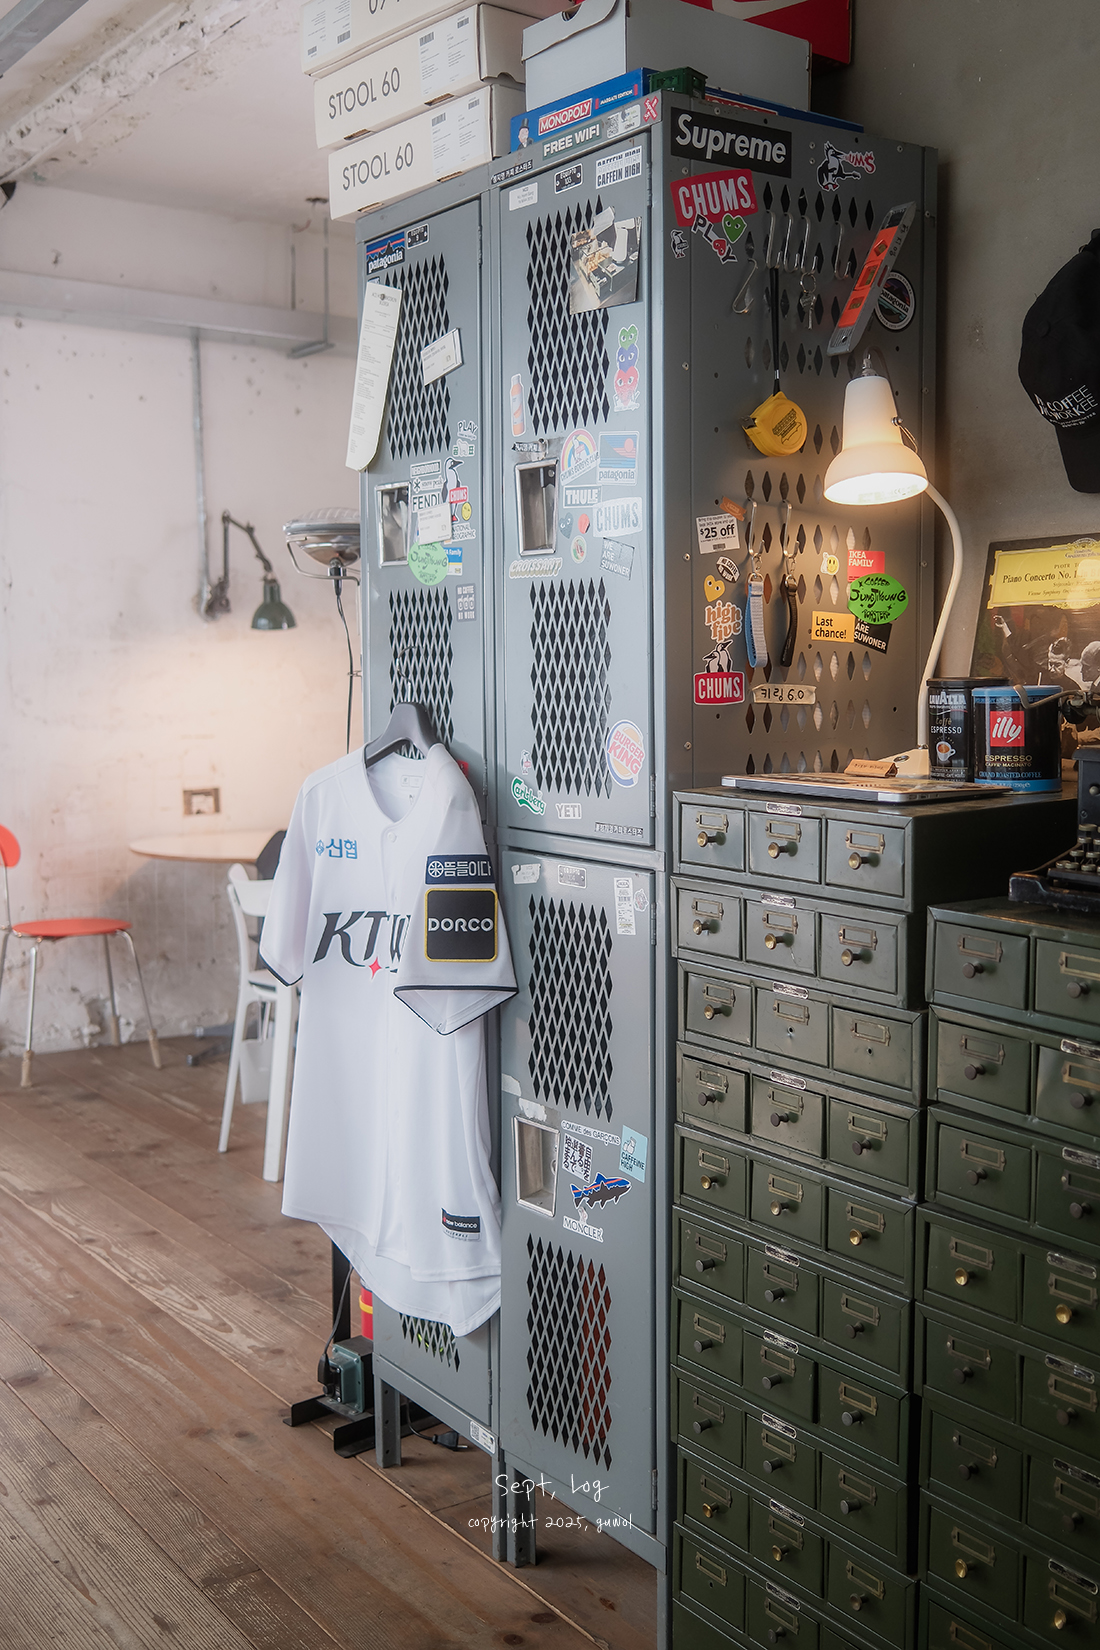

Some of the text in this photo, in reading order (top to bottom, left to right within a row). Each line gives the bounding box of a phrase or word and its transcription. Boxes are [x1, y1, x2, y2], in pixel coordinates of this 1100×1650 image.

[328, 67, 400, 119] STOOL 60
[539, 101, 592, 133] MONOPOLY
[543, 134, 573, 158] FREE
[574, 123, 600, 144] WIFI
[675, 113, 787, 164] Supreme
[342, 142, 414, 190] STOOL 60
[597, 168, 623, 187] CAFFEIN
[624, 162, 640, 178] HIGH
[678, 175, 751, 219] CHUMS
[368, 249, 403, 274] patagonia
[880, 287, 910, 312] atagonia
[1046, 384, 1093, 412] COFFEE
[599, 469, 635, 481] patagonia
[412, 492, 440, 513] FENDI
[566, 488, 599, 505] THULE
[597, 501, 639, 532] CHUMS
[700, 523, 735, 539] $25 off
[603, 540, 613, 549] WE
[849, 550, 867, 559] IKEA
[511, 559, 562, 573] CROISSANT
[602, 551, 615, 562] ARE
[848, 558, 874, 568] FAMILY
[601, 560, 631, 577] SUWONER
[1002, 574, 1022, 583] Piano
[1024, 572, 1055, 582] Concerto
[1059, 570, 1071, 580] No.
[706, 601, 741, 623] high
[816, 616, 833, 627] Last
[711, 621, 741, 642] five
[815, 628, 847, 639] chance!
[855, 622, 870, 635] ARE
[854, 631, 887, 650] SUWONER
[698, 677, 741, 700] CHUMS
[787, 689, 805, 701] 6.0
[930, 725, 962, 734] ESPRESSO
[992, 716, 1022, 744] illy
[613, 730, 645, 762] BURGER
[608, 742, 641, 775] KING
[985, 754, 1033, 762] ESPRESSO
[512, 778, 546, 814] Carlsberg
[556, 804, 581, 818] YETI
[325, 838, 358, 860] 신협
[444, 861, 491, 877] 뜸들이다
[427, 917, 494, 932] DORCO
[454, 1221, 478, 1229] balance
[564, 1217, 603, 1241] MONCLER
